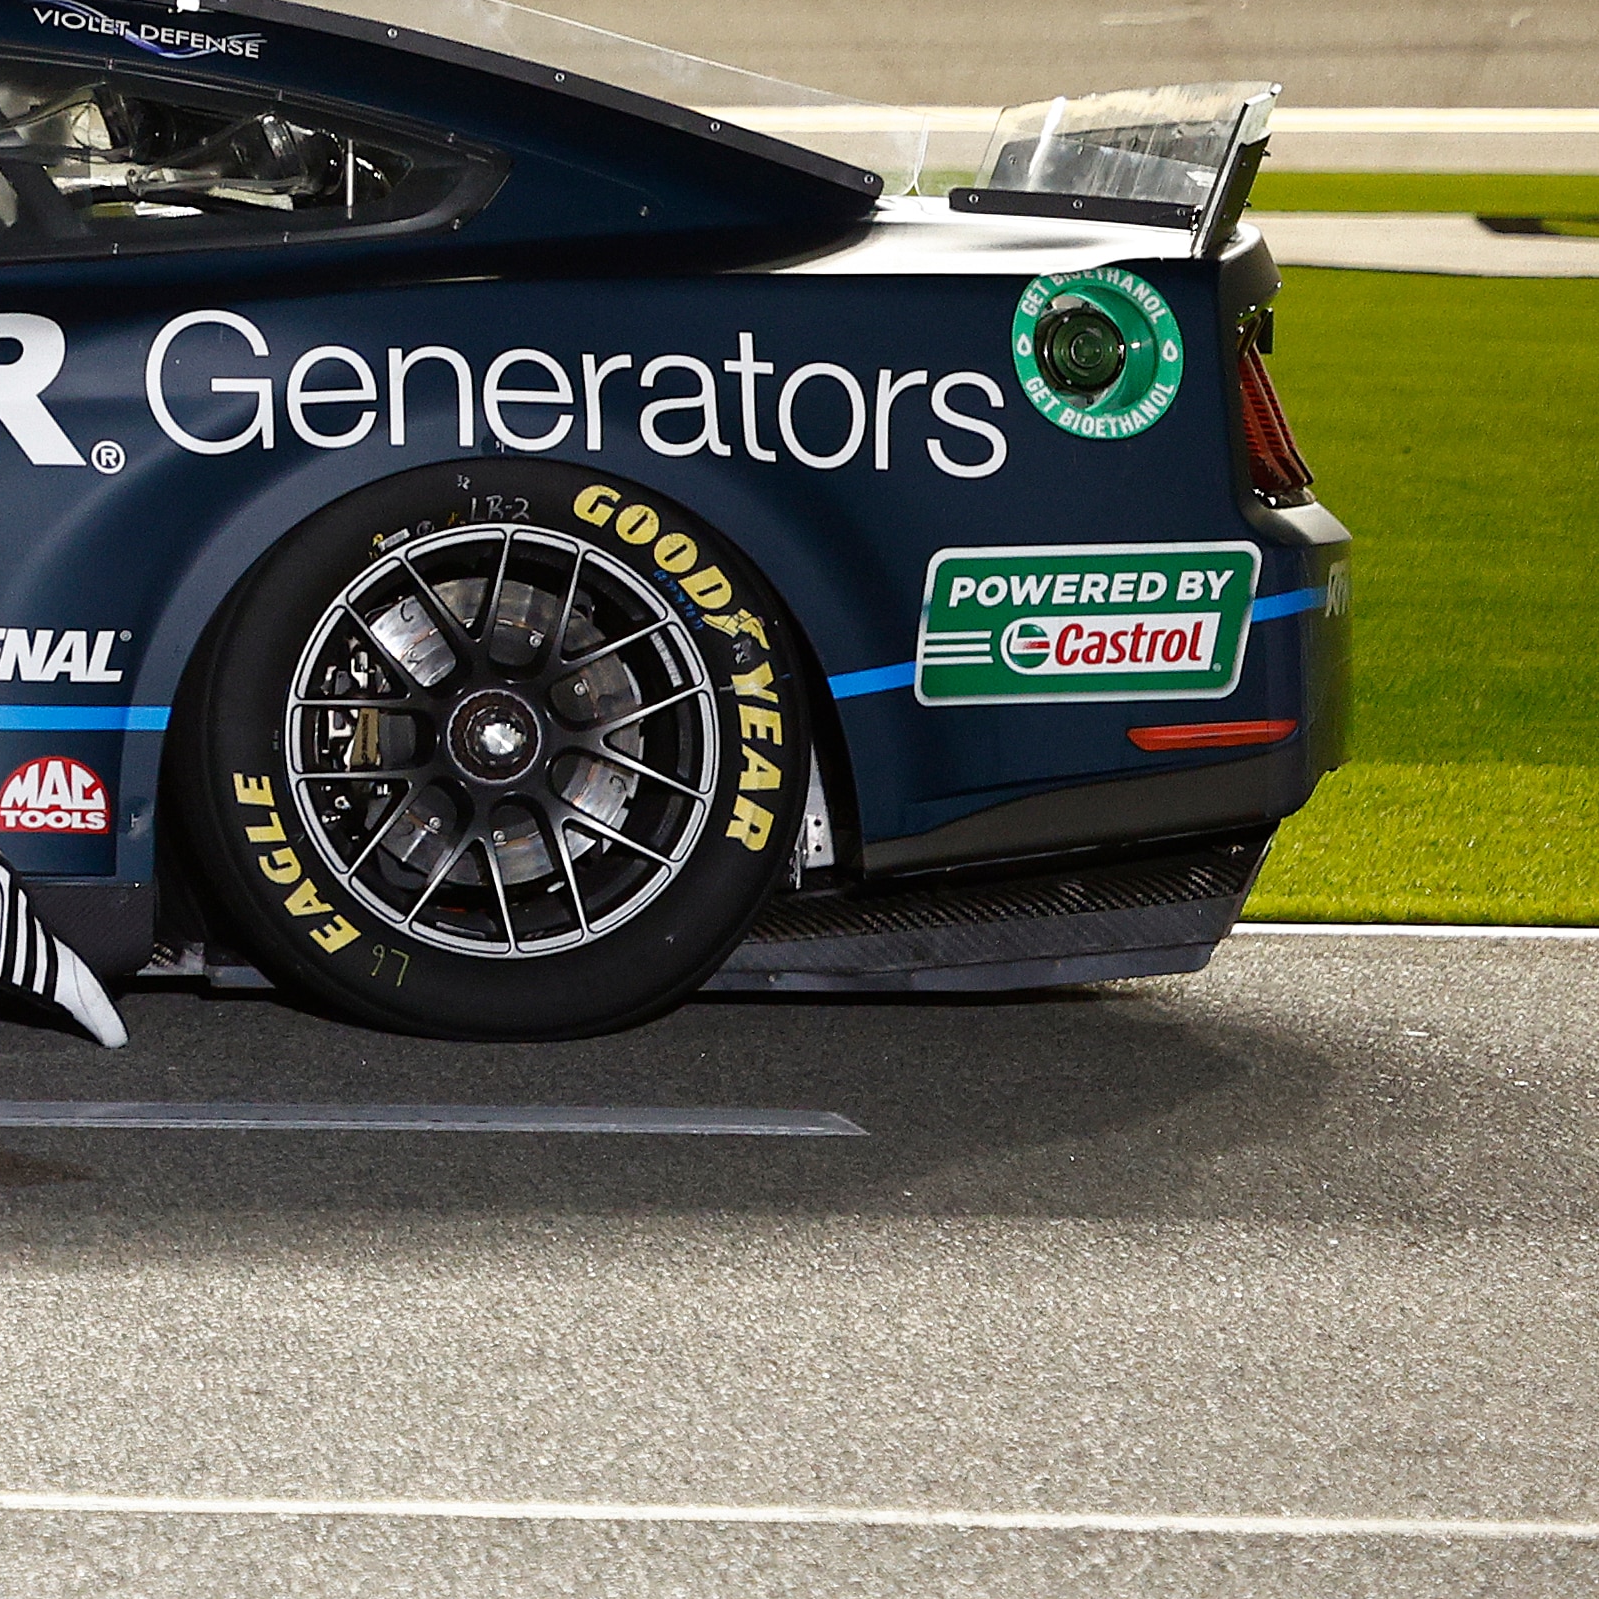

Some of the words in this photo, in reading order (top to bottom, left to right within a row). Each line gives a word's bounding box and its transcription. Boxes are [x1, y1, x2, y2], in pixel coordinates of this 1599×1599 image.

[33, 6, 131, 37] VIOLET
[140, 23, 260, 60] DEFENSE
[1021, 280, 1050, 318] GET
[144, 309, 1008, 479] Generators
[1025, 376, 1060, 413] GET
[1058, 382, 1175, 437] BIOETHANOL
[948, 570, 1167, 608] POWERED
[1175, 569, 1235, 601] BY
[1054, 619, 1205, 667] Castrol
[1, 760, 106, 811] MAC
[0, 809, 107, 831] TOOLS
[233, 772, 362, 954] EAGLE
